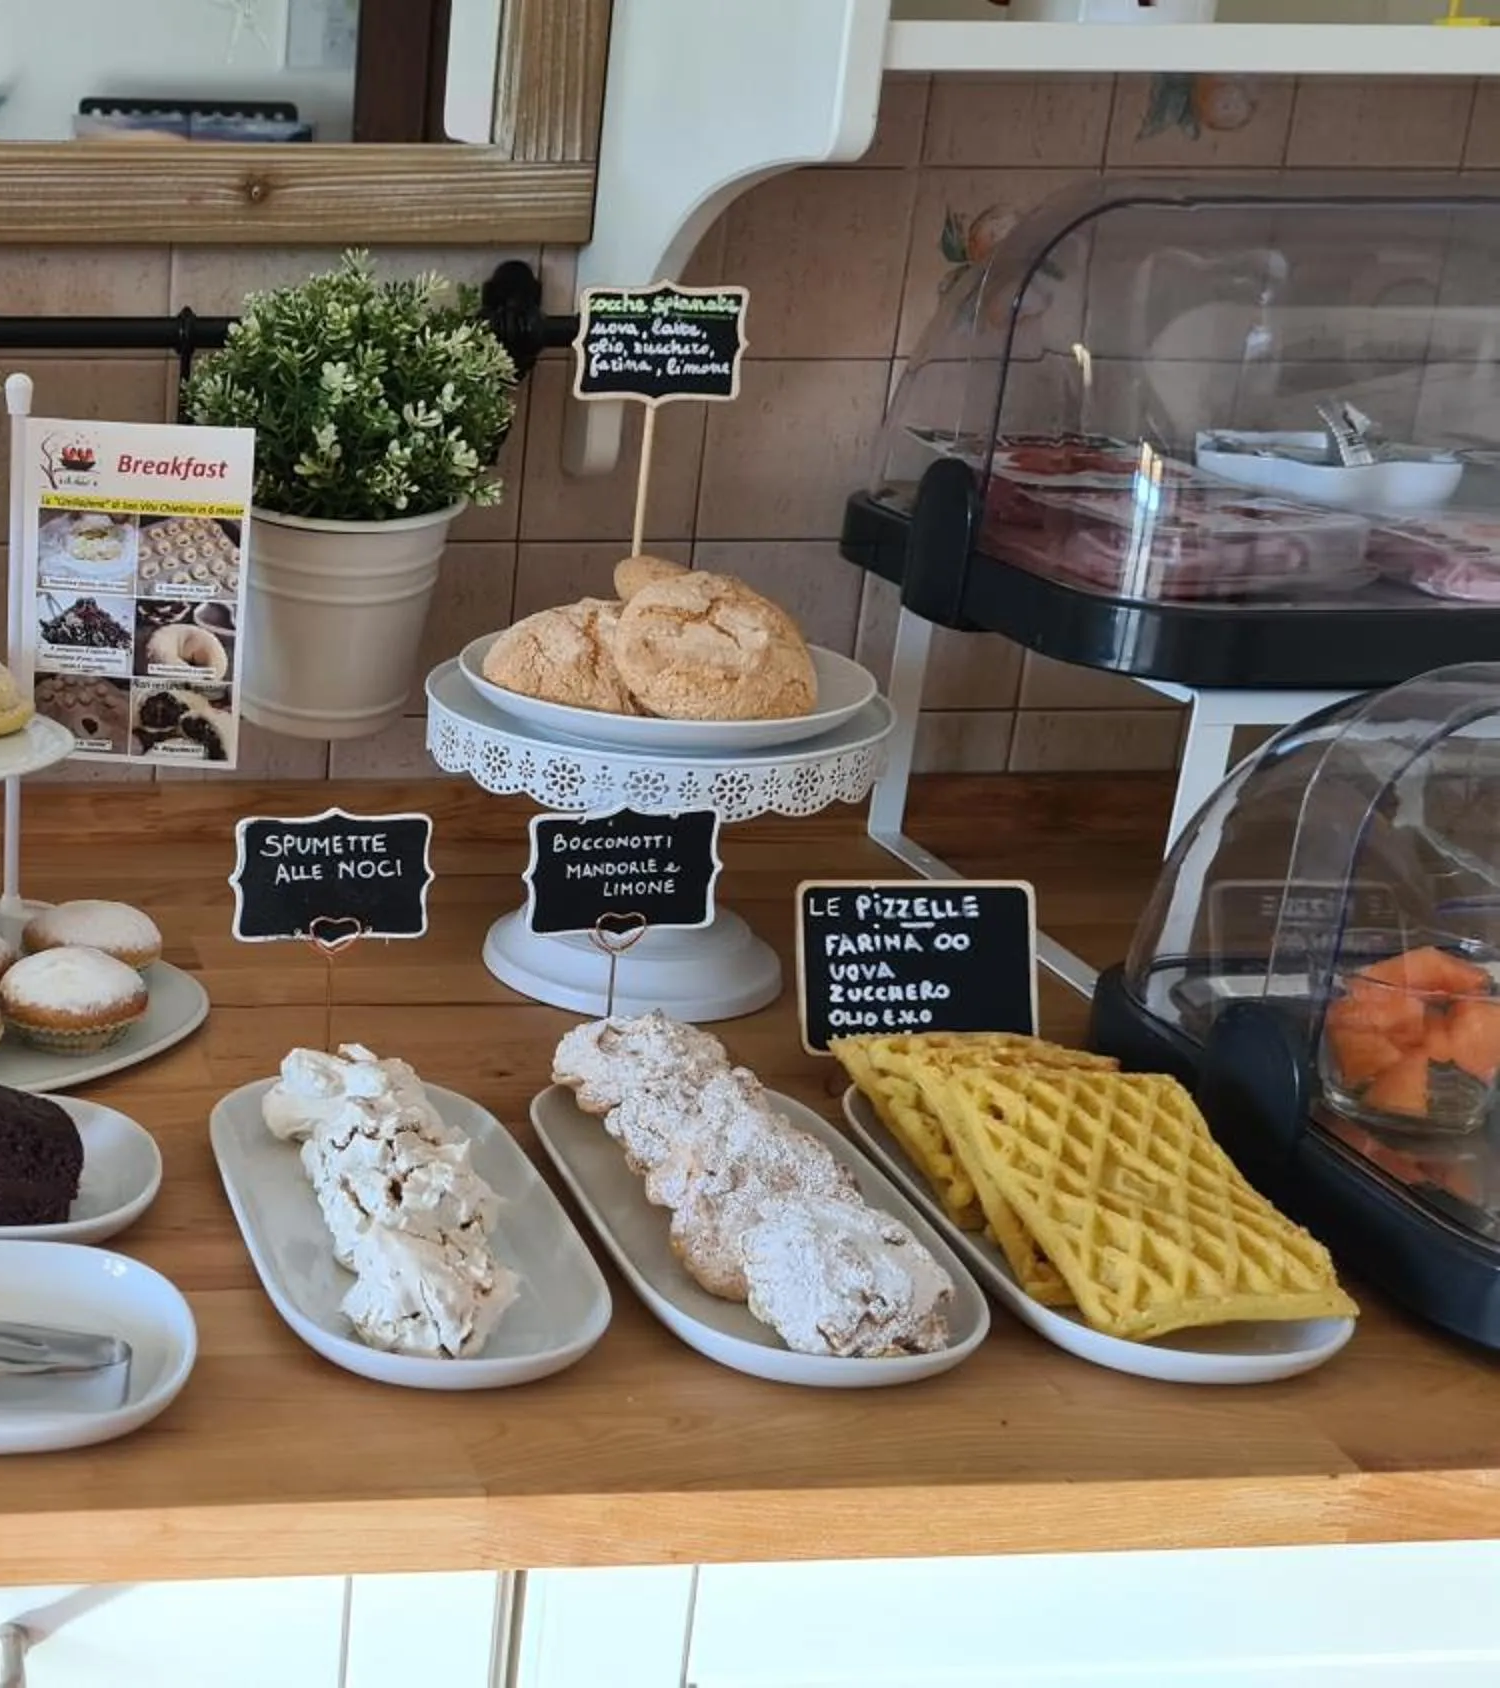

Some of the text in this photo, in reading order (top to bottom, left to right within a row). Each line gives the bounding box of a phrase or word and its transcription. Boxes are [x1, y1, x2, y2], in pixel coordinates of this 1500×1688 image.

[117, 453, 228, 482] Breakfast
[260, 833, 387, 857] SPUMETTE
[275, 859, 402, 885] ALLE NOCI
[566, 859, 658, 880] MANDORLE
[603, 879, 676, 897] LIMONE
[809, 897, 841, 917] LE
[829, 961, 896, 982] UOVA
[828, 980, 951, 1003] ZUCCHERO
[827, 1009, 878, 1027] OLIO
